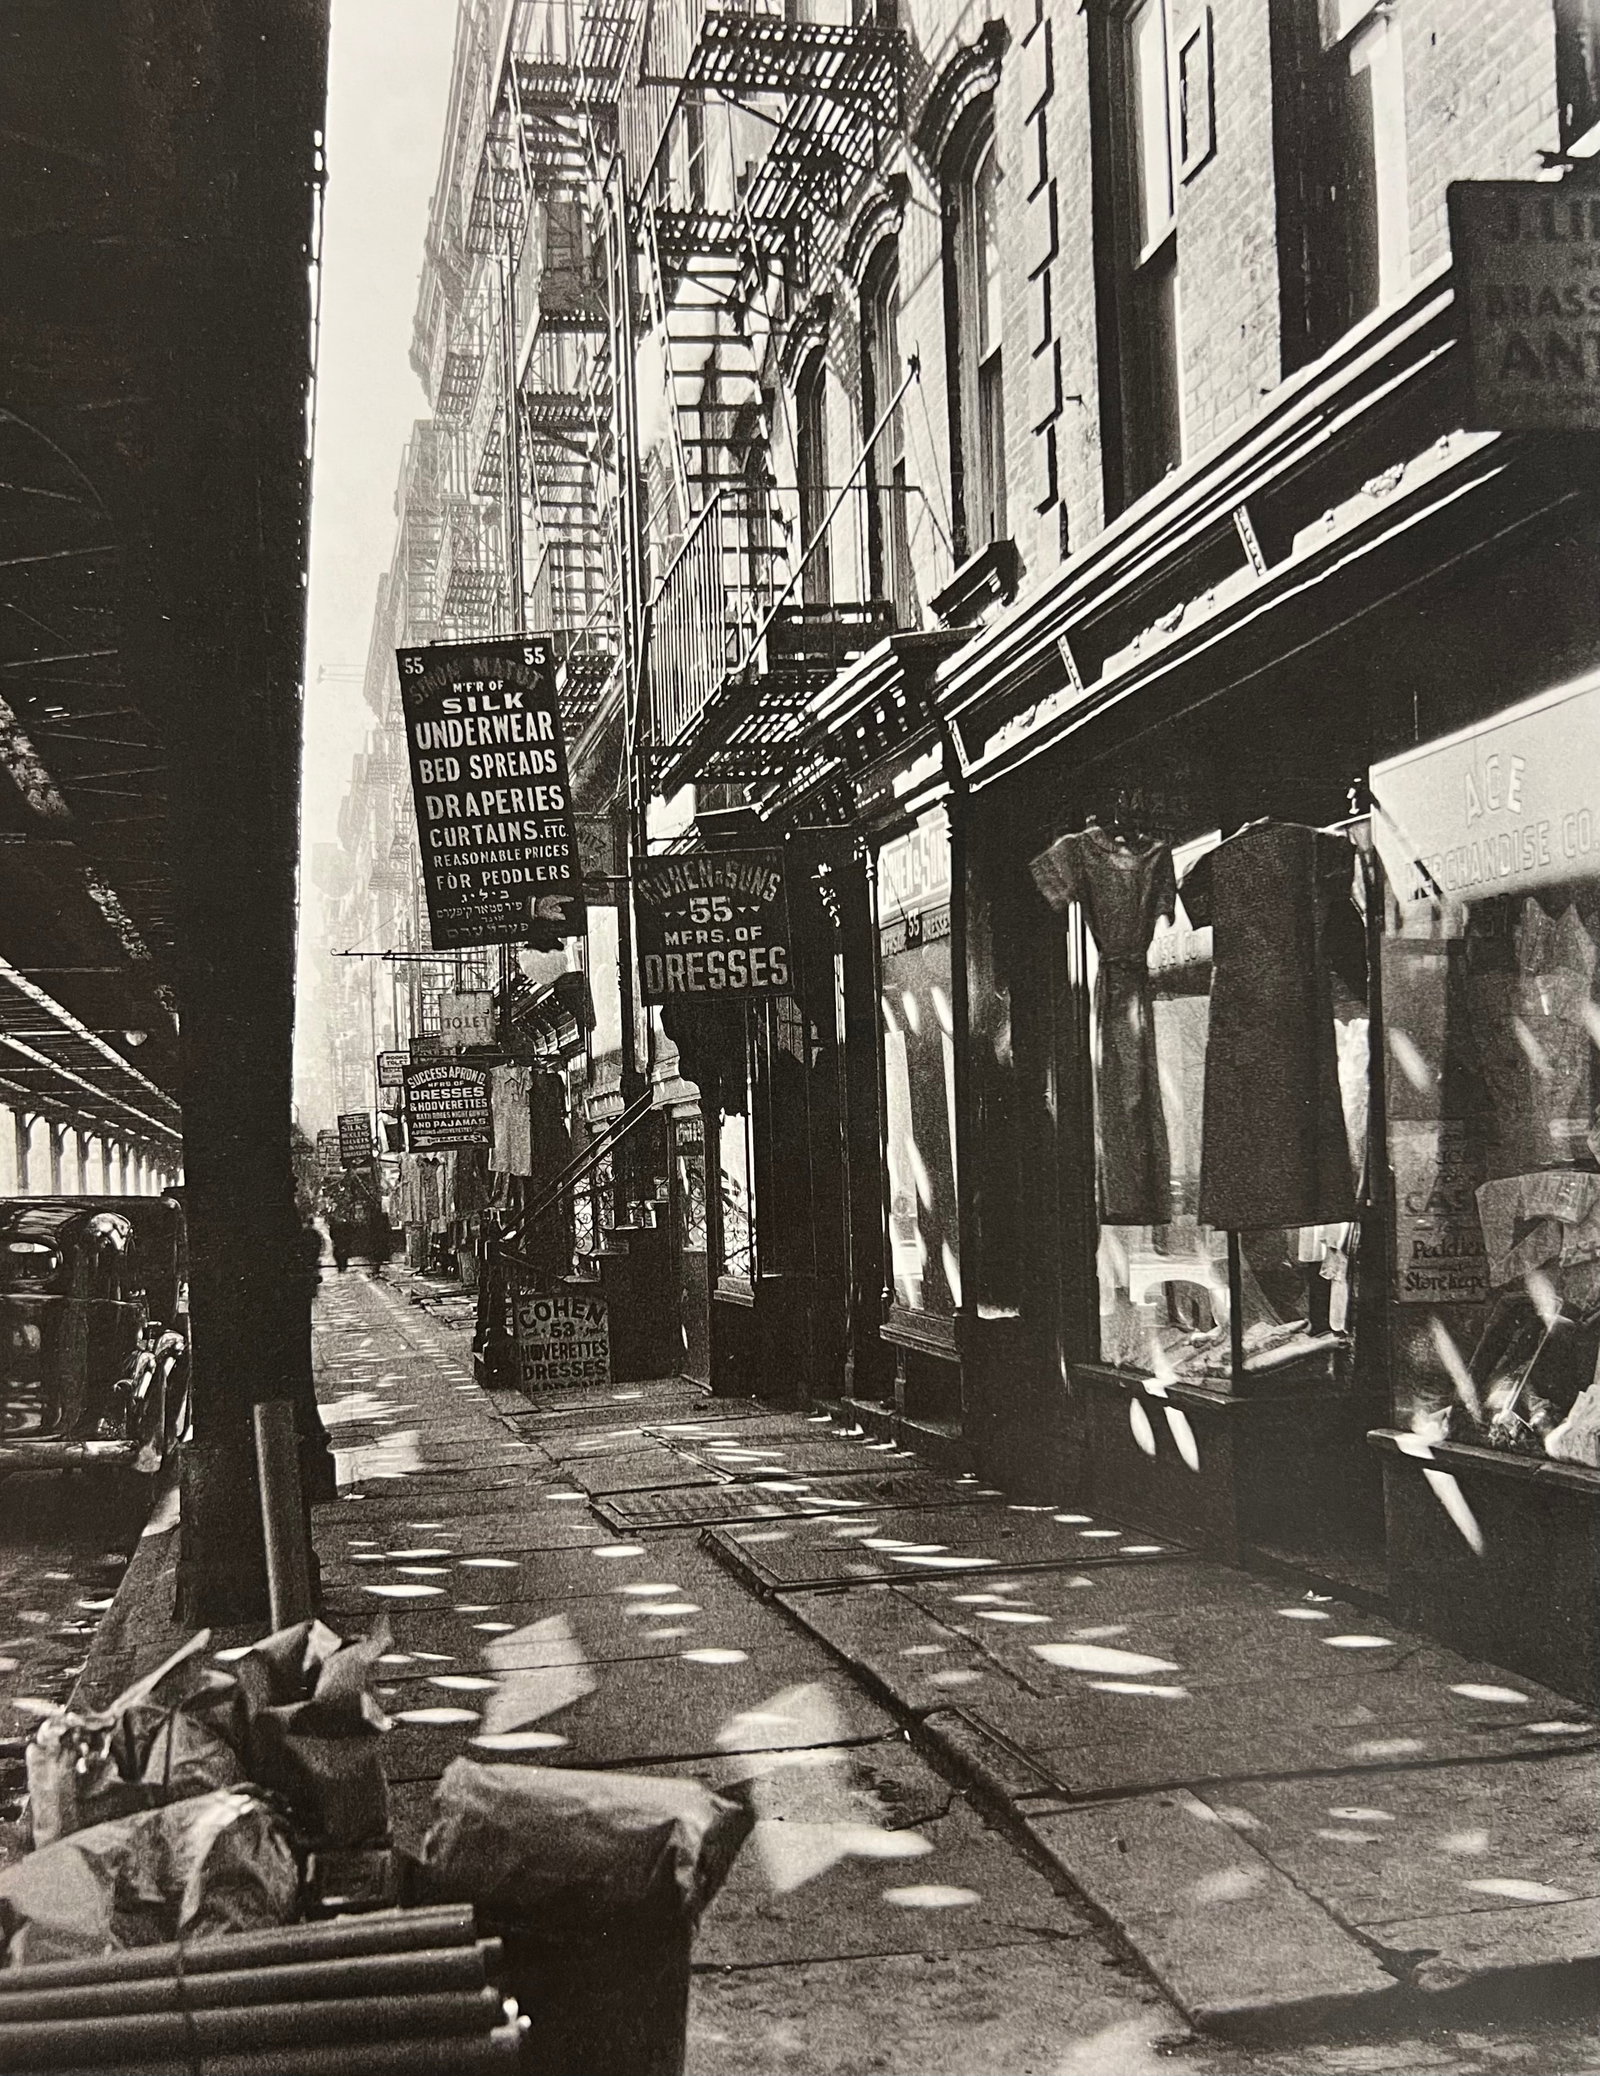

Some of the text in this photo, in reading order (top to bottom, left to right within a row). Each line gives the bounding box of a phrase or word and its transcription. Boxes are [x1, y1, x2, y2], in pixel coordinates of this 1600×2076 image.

[404, 657, 424, 676] 55
[523, 648, 546, 667] 55
[488, 680, 504, 691] OF
[442, 691, 524, 716] SILK
[415, 710, 555, 750] UNDERWEAR
[419, 749, 558, 784] BED SPREADS
[425, 784, 564, 821] DRAPERIES
[1464, 753, 1526, 829] ACE
[434, 850, 521, 868] REASONABLE
[525, 843, 569, 860] PRICES
[436, 864, 571, 891] FOR PEDDLERS
[689, 896, 733, 923] 55
[907, 907, 919, 937] 55
[664, 926, 762, 946] MFRS. OF
[645, 946, 788, 994] DRESSES
[407, 1066, 448, 1089] SUCCESS
[449, 1066, 478, 1082] APRON
[410, 1086, 485, 1101] DRESSES
[413, 1121, 431, 1129] AND
[519, 1298, 607, 1329] COHEN
[523, 1360, 607, 1381] DRESSES
